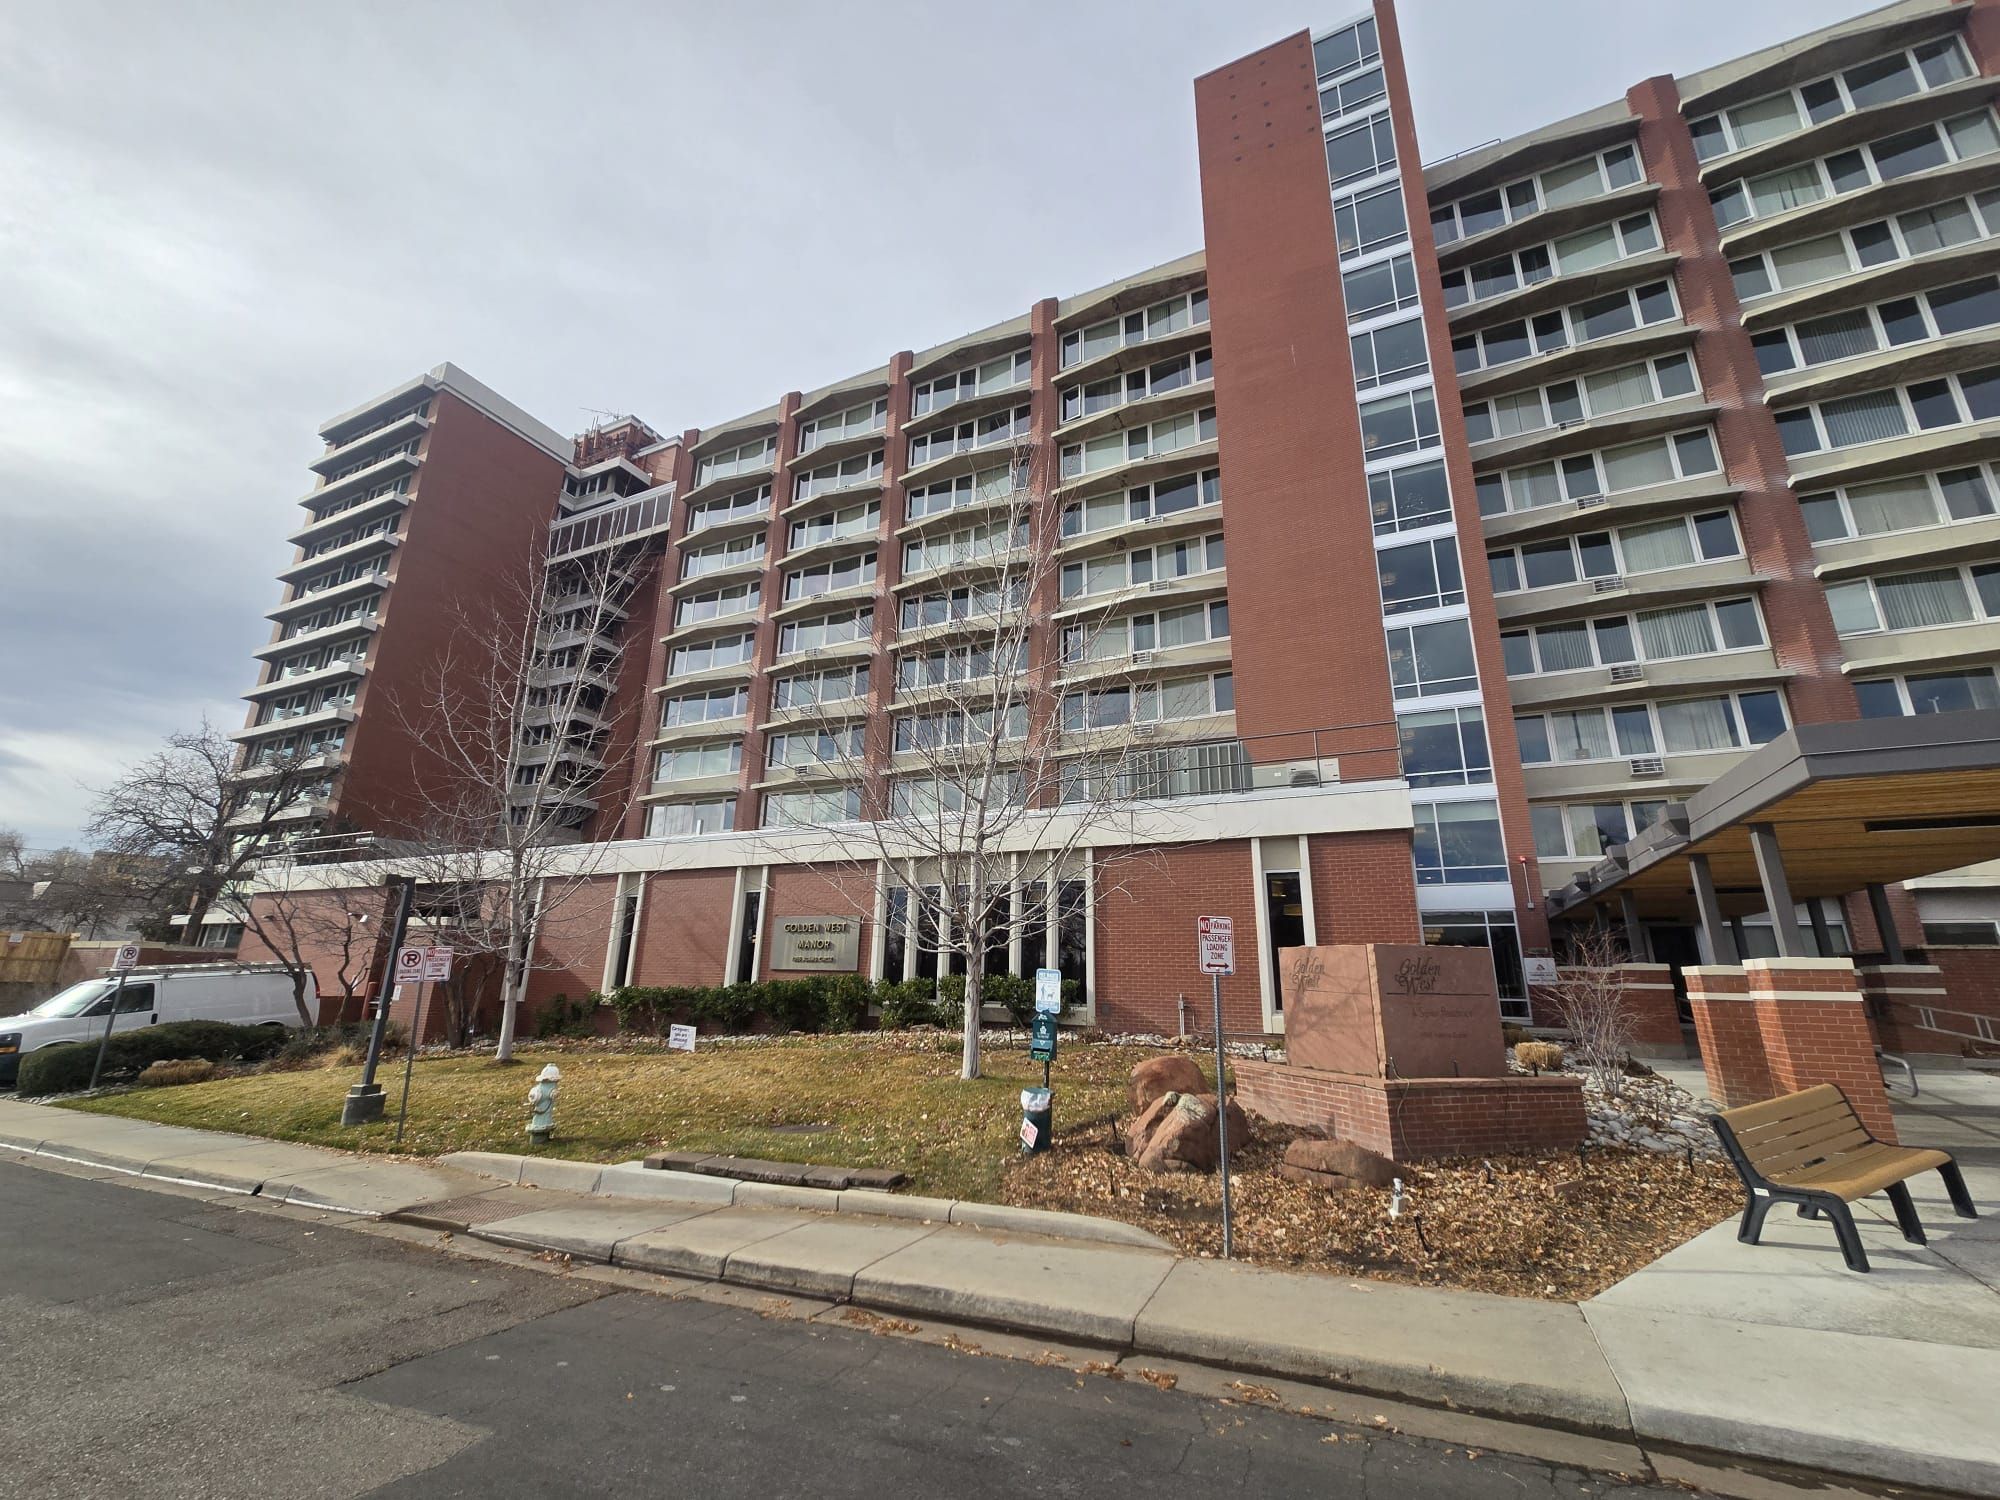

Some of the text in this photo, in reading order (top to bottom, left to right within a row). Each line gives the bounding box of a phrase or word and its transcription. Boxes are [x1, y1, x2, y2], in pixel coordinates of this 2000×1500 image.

[783, 922, 848, 933] GOLDEN WEST
[1200, 920, 1231, 931] NO PARKING
[1202, 934, 1232, 942] PASSENGER
[797, 940, 831, 950] MANOR
[1206, 943, 1228, 951] LOADING
[1210, 952, 1225, 960] ZONE
[1293, 957, 1325, 974] Golden
[1400, 957, 1441, 976] Golden
[1290, 973, 1320, 993] West
[1394, 974, 1436, 994] West
